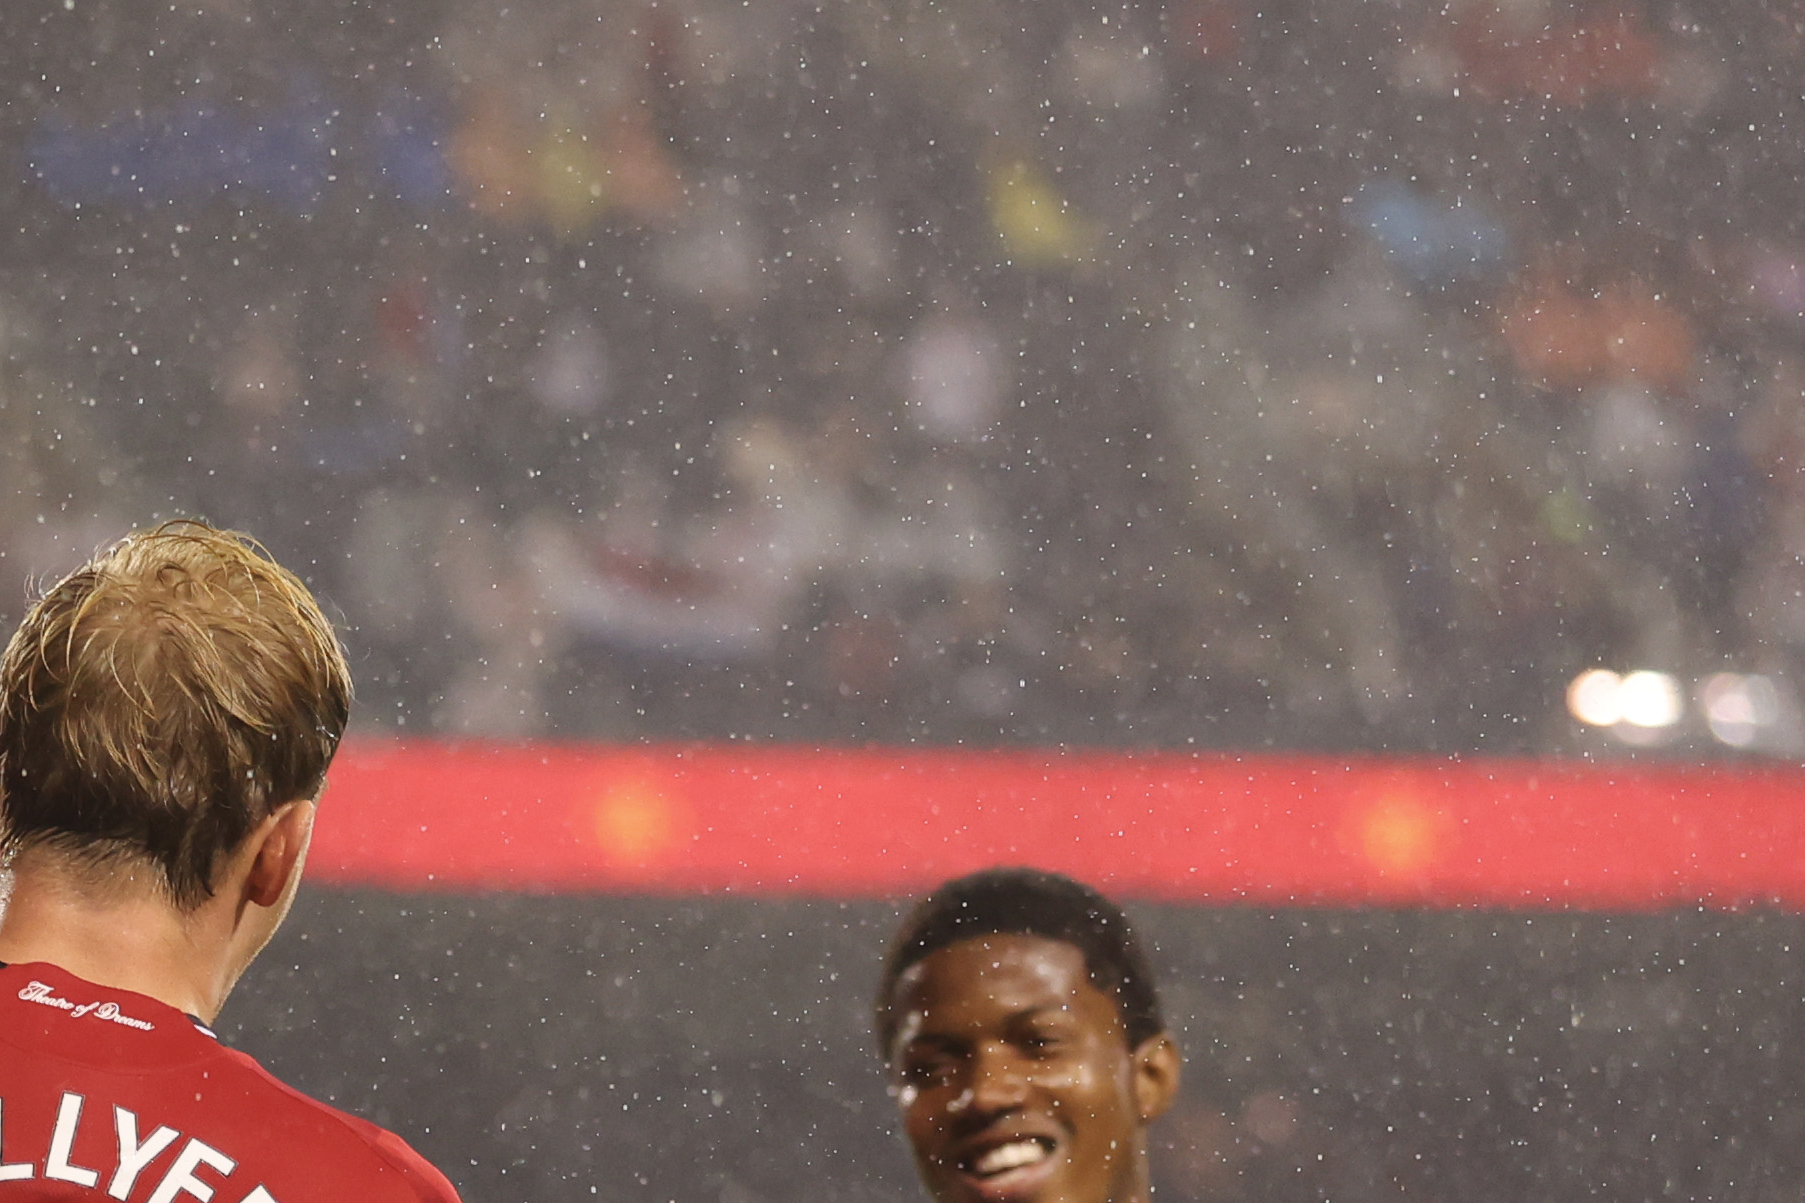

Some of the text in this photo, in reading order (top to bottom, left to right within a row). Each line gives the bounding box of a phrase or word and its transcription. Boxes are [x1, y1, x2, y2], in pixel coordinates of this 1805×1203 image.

[18, 980, 156, 1031] Theatre of Dreams
